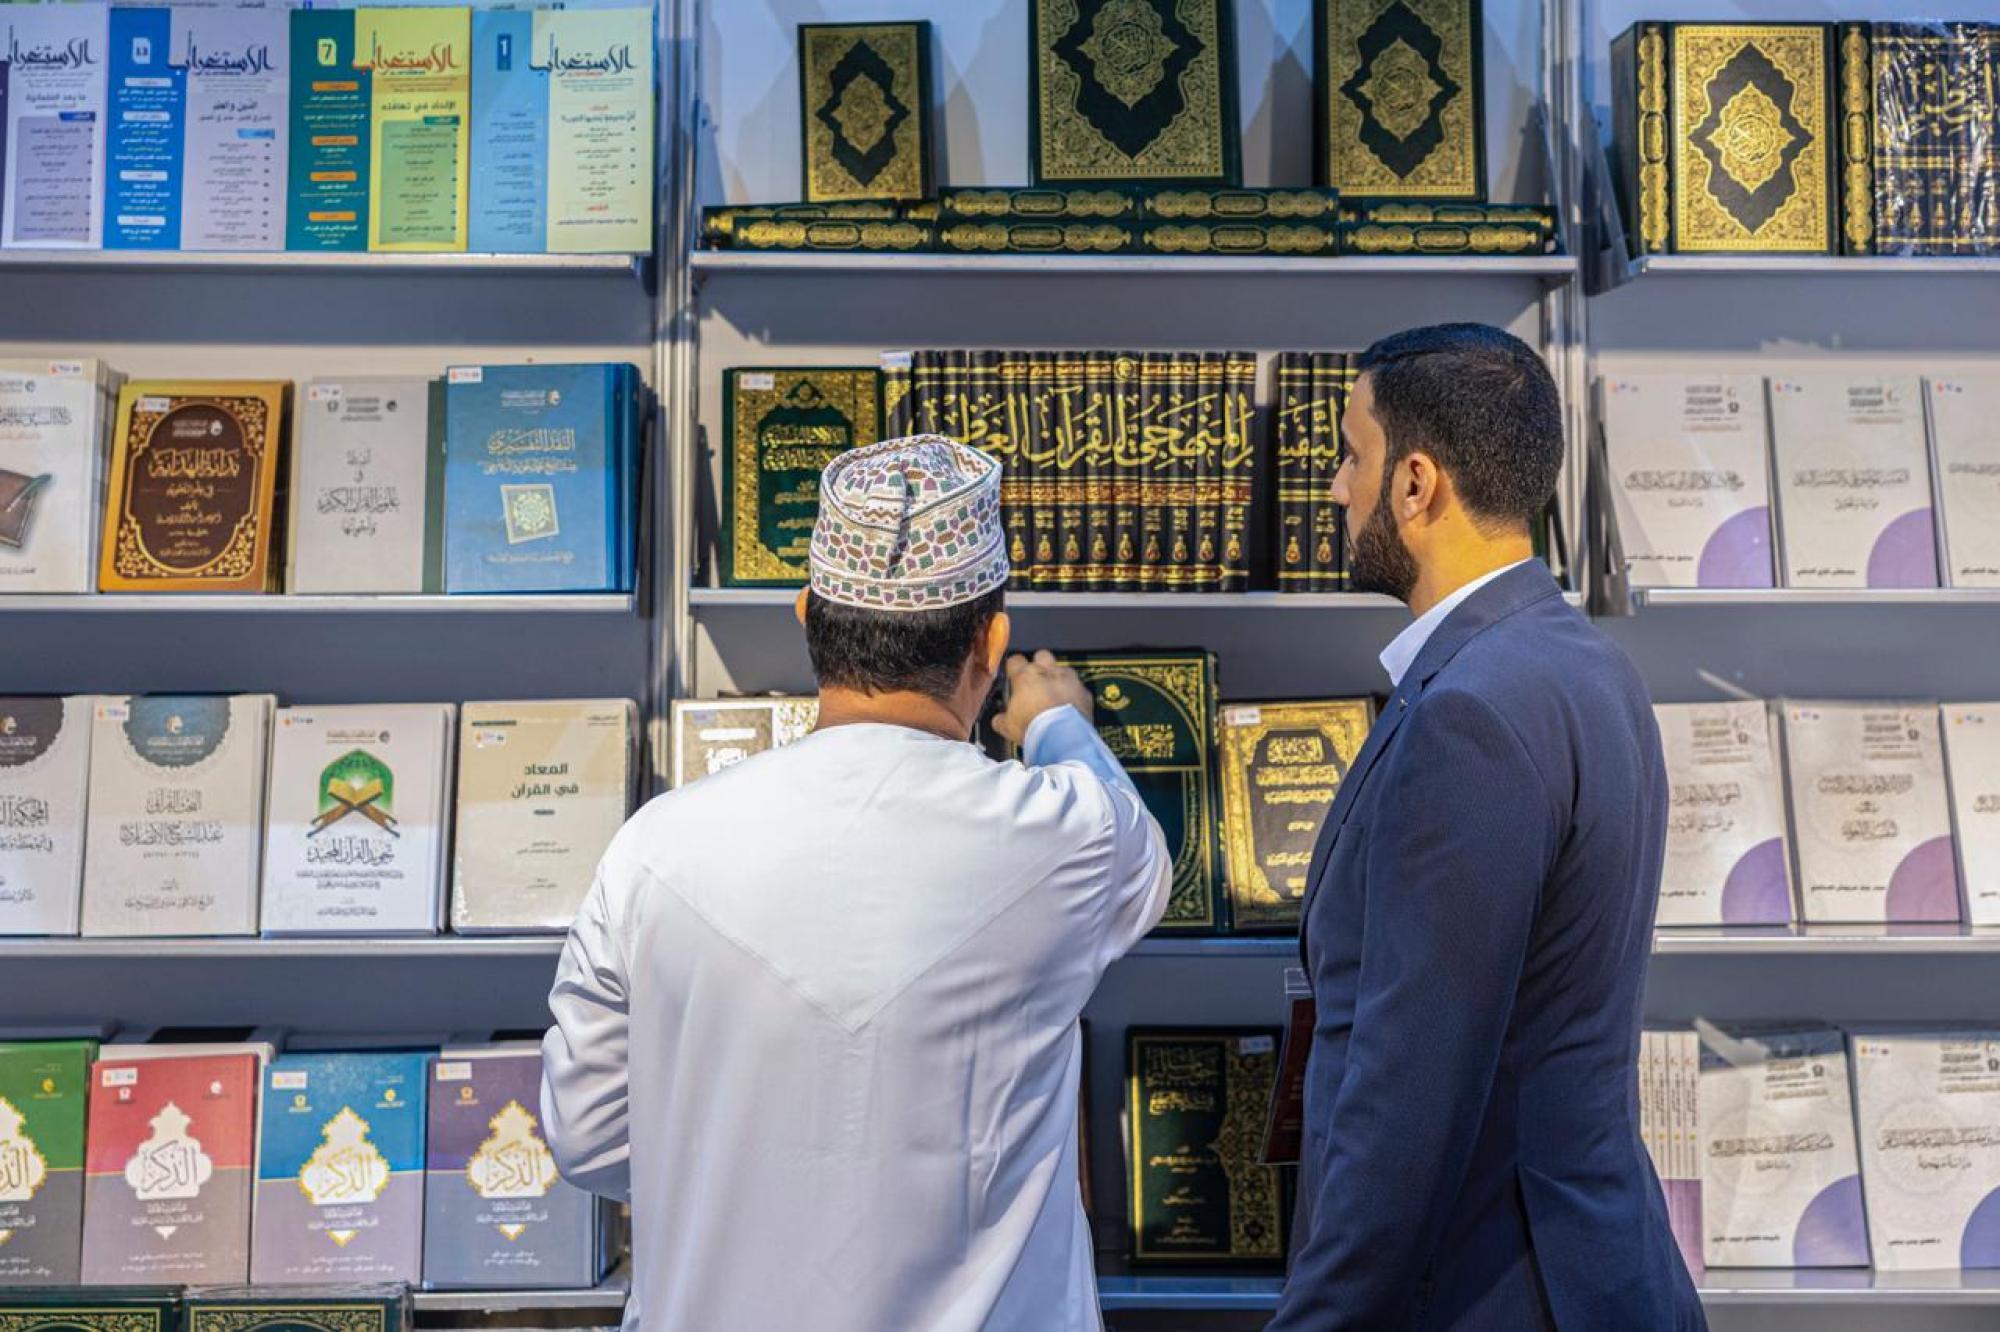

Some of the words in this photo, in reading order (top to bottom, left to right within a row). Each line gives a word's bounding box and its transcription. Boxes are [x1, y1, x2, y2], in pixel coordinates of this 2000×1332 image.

[321, 43, 333, 60] 7
[499, 39, 508, 56] 1
[525, 763, 569, 776] المعاد
[554, 783, 579, 797] في
